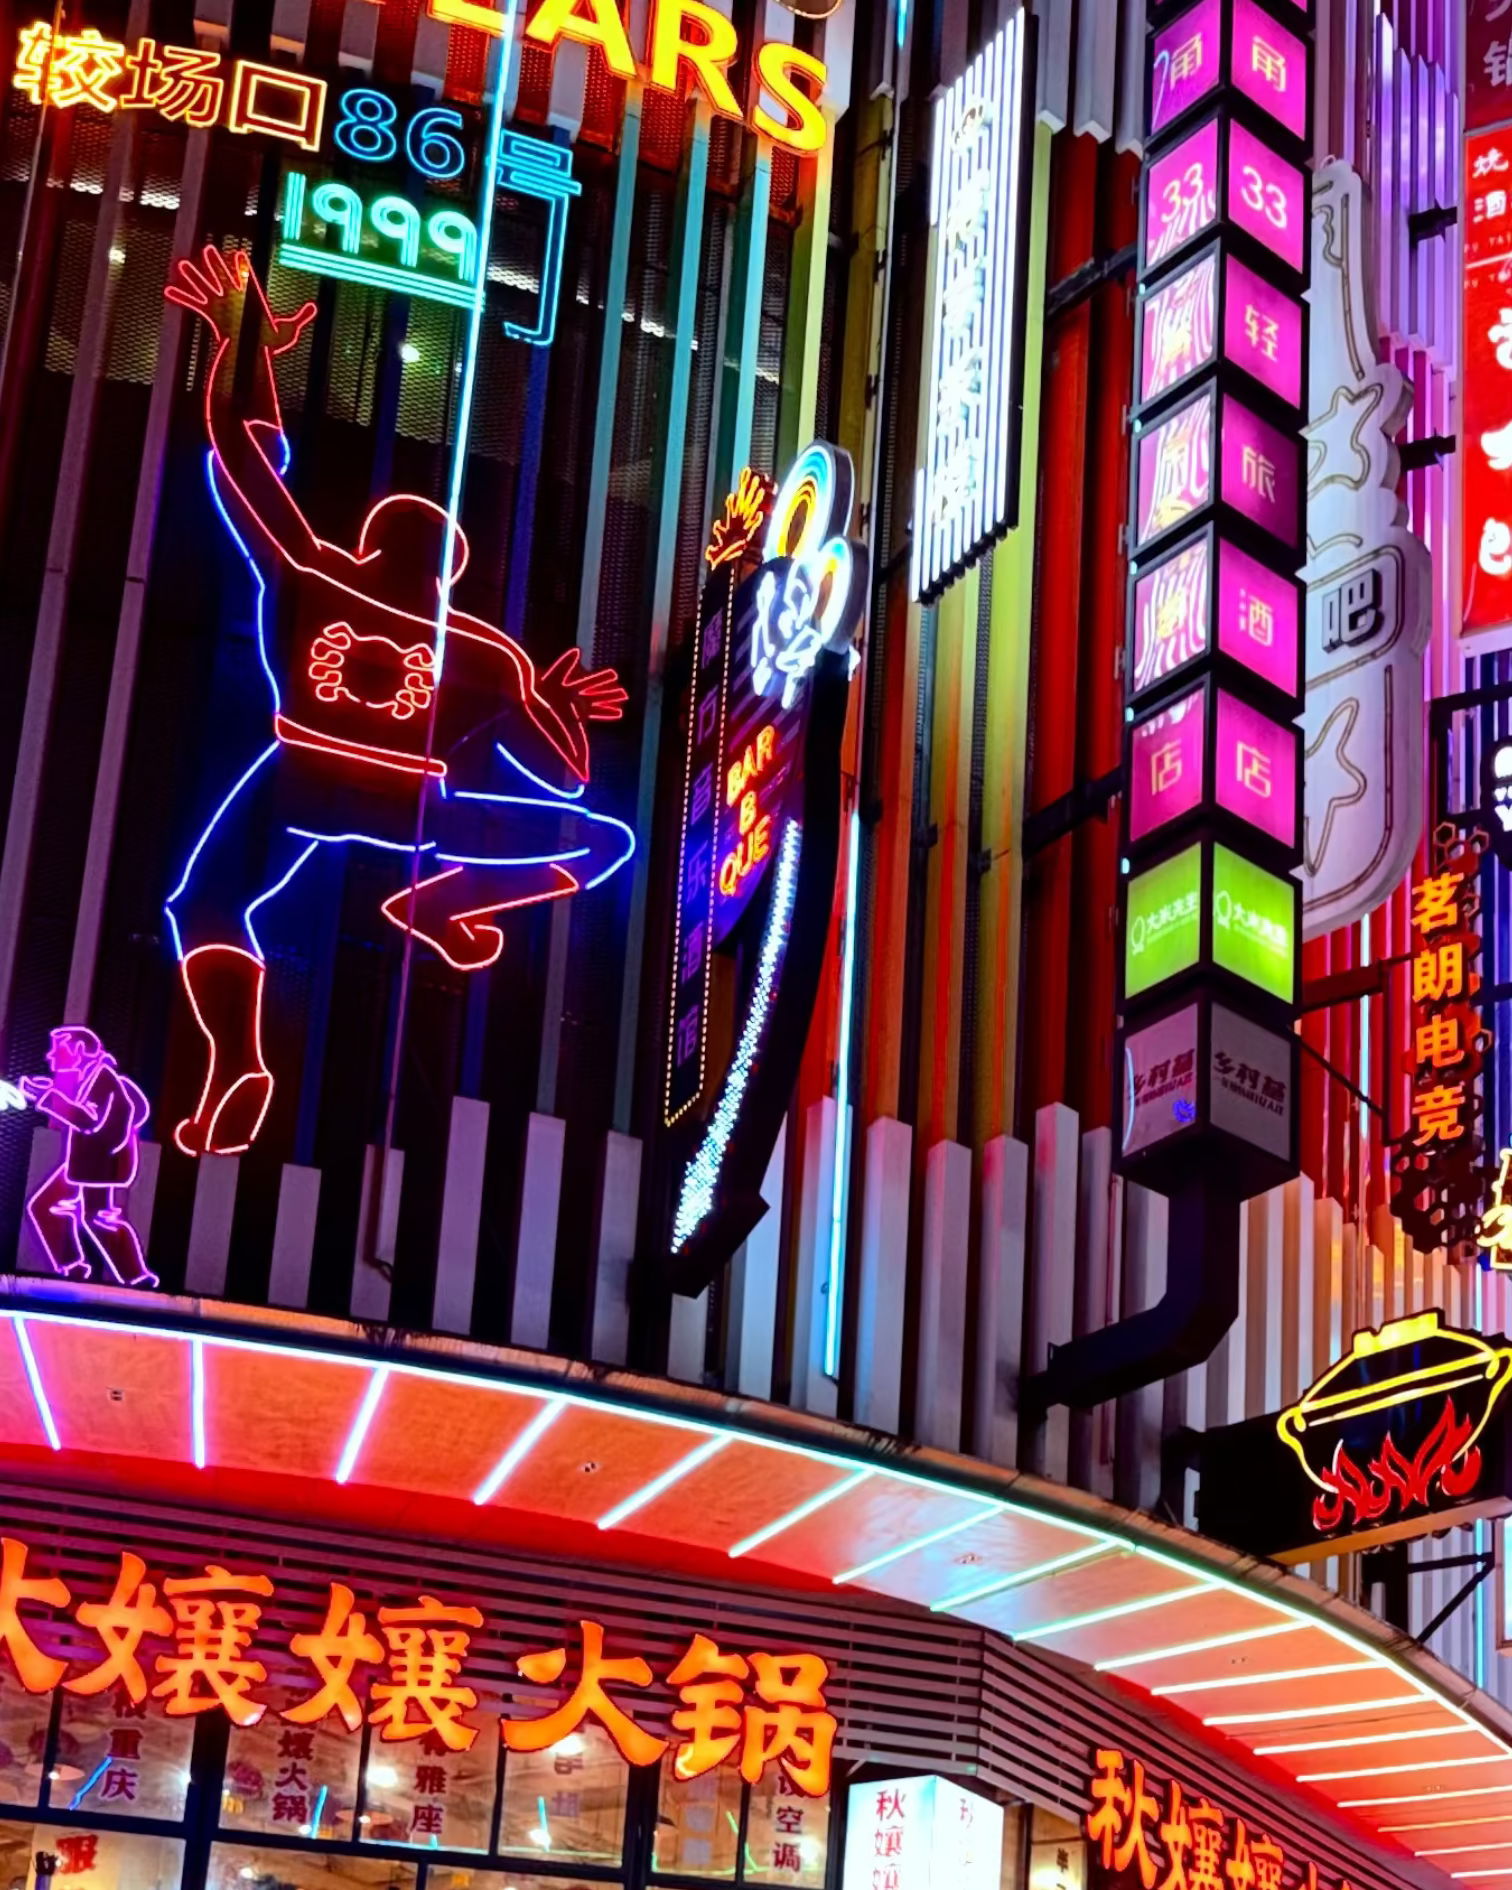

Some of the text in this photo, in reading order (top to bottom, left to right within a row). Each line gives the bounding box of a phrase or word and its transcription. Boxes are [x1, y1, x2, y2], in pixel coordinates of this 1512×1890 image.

[429, 0, 827, 153] ARS
[285, 172, 482, 281] 1999
[1321, 568, 1382, 654] 吧
[727, 725, 775, 807] BAR
[719, 815, 771, 897] QUE
[739, 791, 757, 835] B
[1412, 872, 1466, 1146] 茗朗电竞
